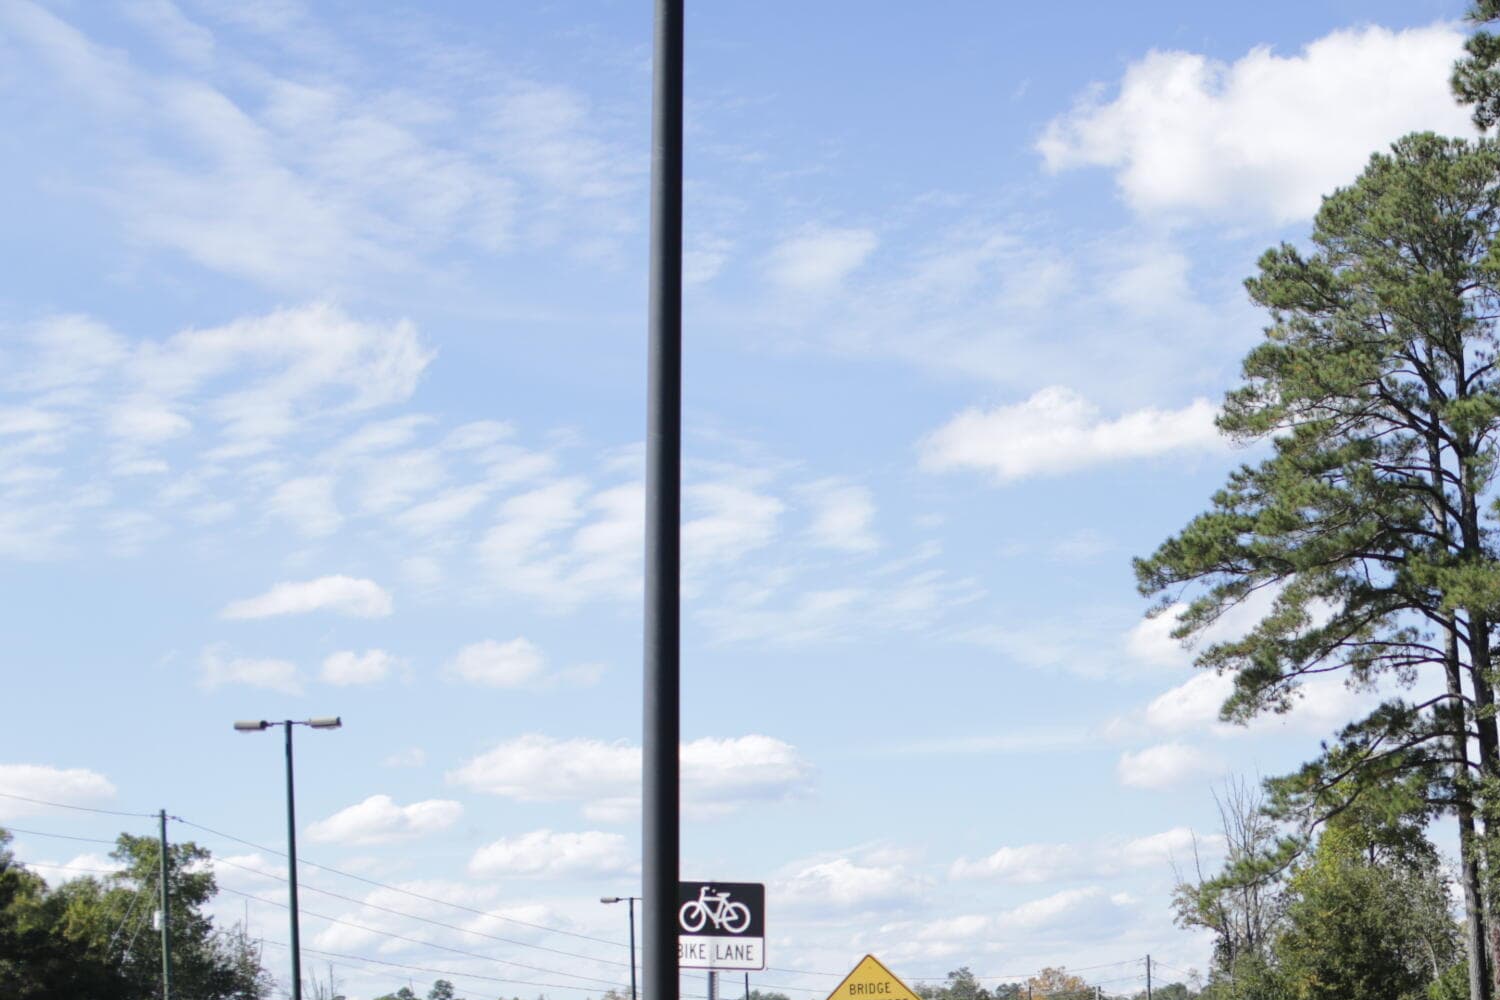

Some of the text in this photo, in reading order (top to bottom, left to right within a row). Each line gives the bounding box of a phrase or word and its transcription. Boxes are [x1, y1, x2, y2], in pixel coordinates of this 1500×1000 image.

[678, 943, 754, 961] BIKE LANE
[849, 982, 891, 996] BRIDGE
